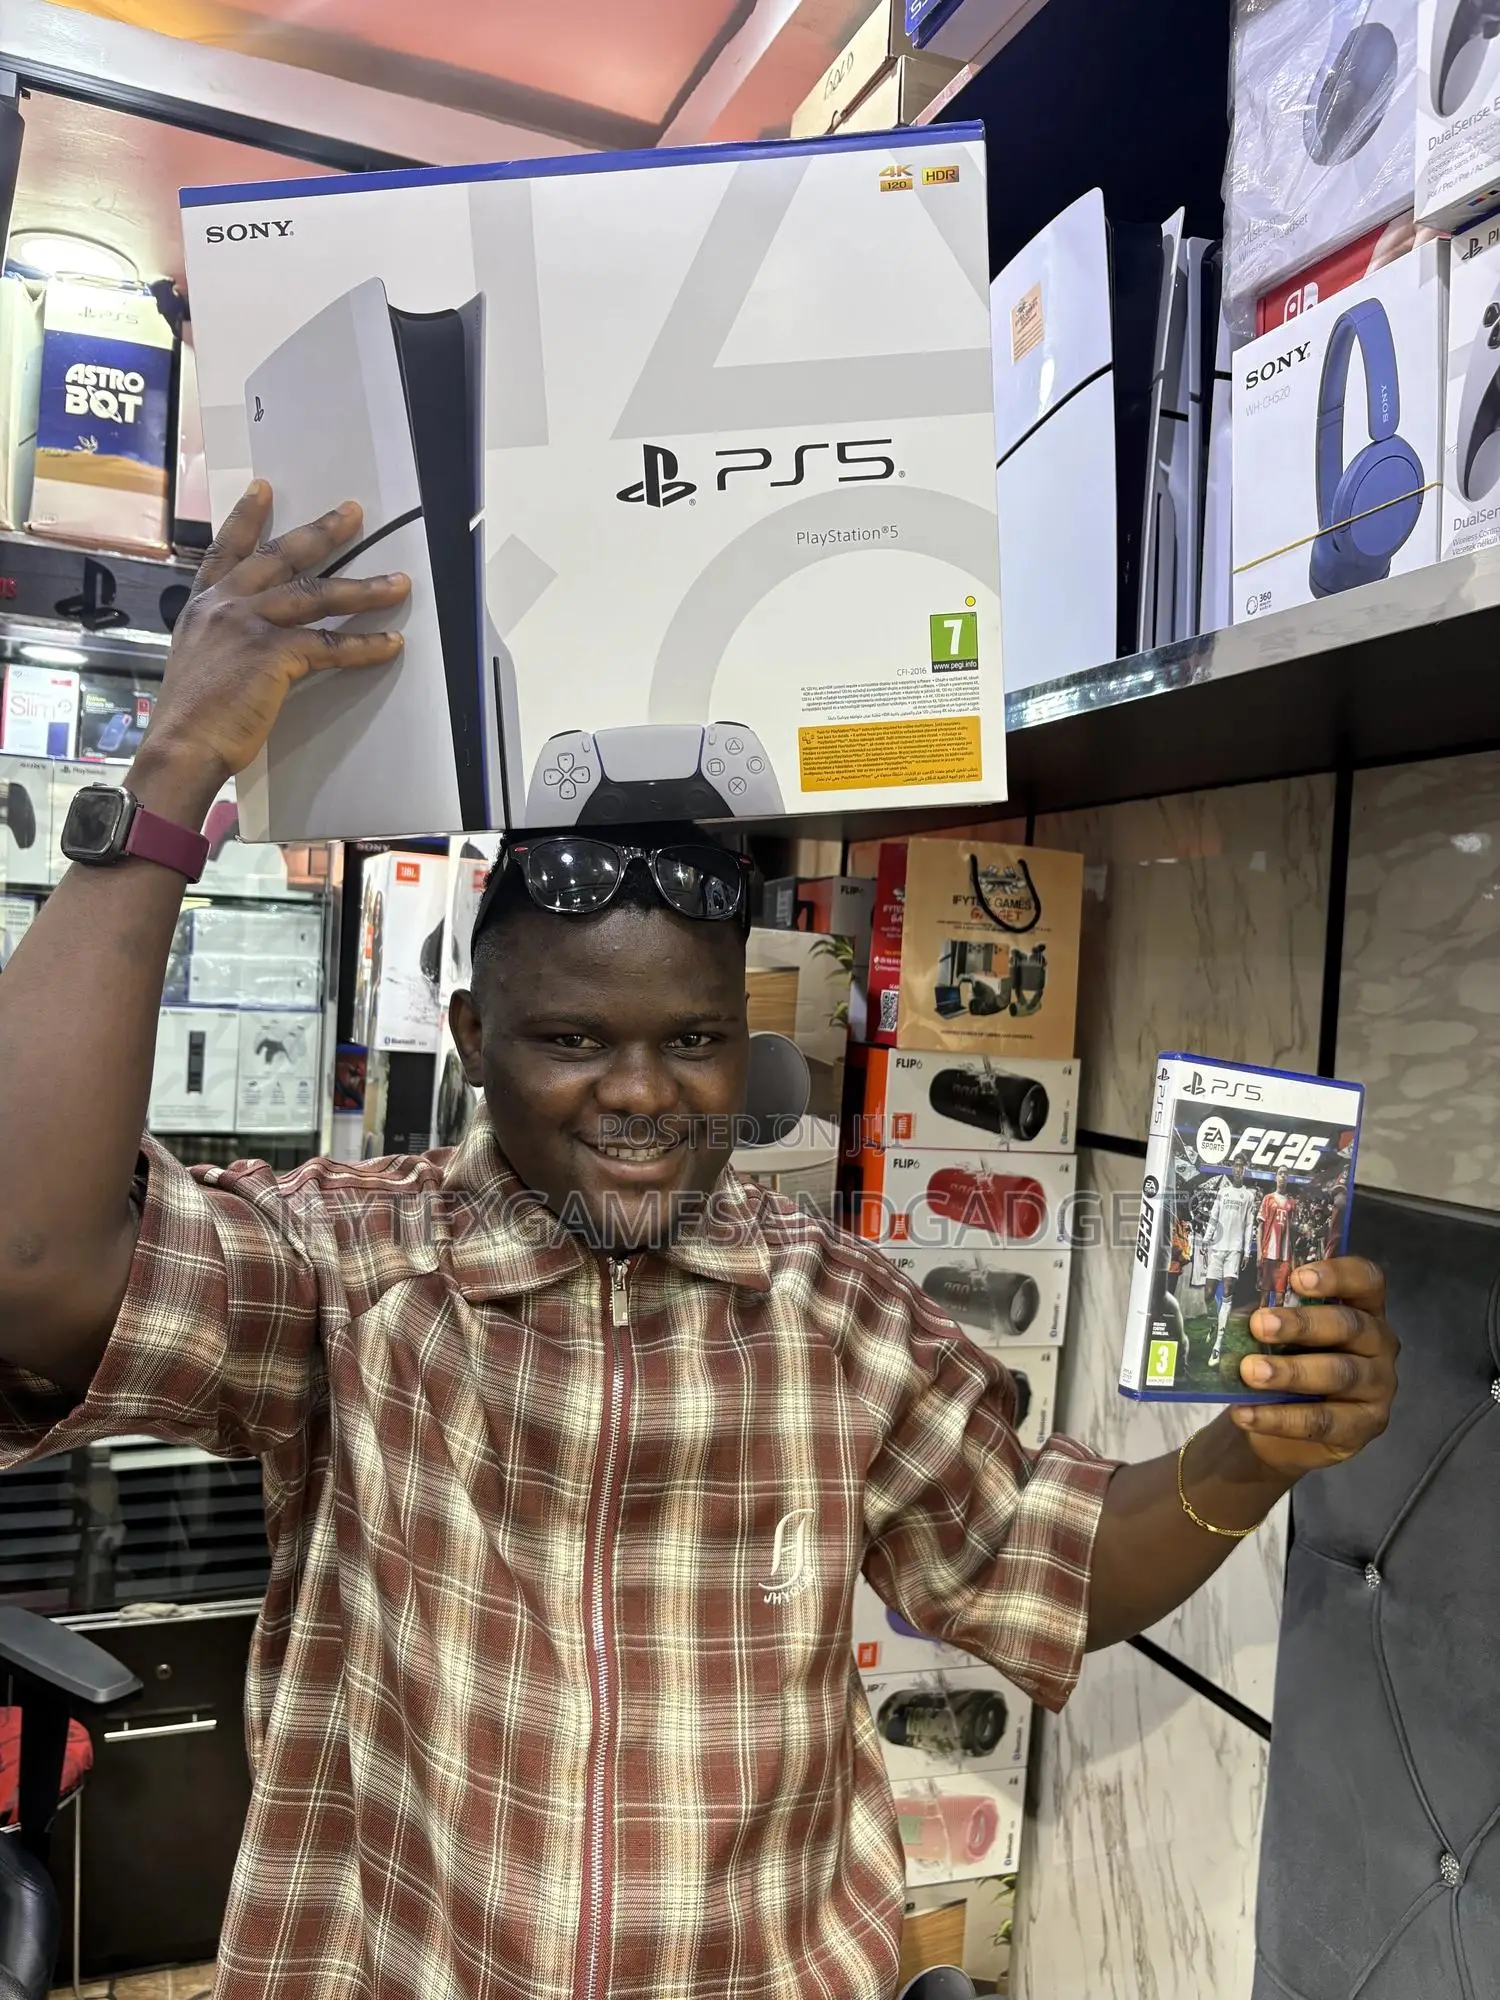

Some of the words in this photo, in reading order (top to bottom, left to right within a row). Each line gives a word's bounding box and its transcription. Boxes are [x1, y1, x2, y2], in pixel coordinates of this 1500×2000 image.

[1428, 106, 1490, 151] DualSense
[879, 164, 914, 178] 4K
[926, 169, 956, 182] HDR
[888, 181, 907, 190] 120
[206, 220, 292, 244] SONY
[65, 363, 145, 393] ASTRO
[1246, 341, 1311, 391] SONY
[65, 384, 143, 424] BOT
[1246, 385, 1291, 417] WH-CH520
[1381, 384, 1389, 423] SONY
[715, 438, 896, 491] PS5
[1260, 591, 1271, 602] 360
[943, 619, 963, 656] 7
[896, 667, 927, 677] CFI-2016
[933, 661, 977, 671] www.pegi.info
[1154, 1084, 1166, 1124] PS5
[1211, 1079, 1263, 1102] PS5
[1201, 1141, 1225, 1153] SPORTS
[1202, 1127, 1225, 1144] EA
[1155, 1344, 1169, 1375] 3
